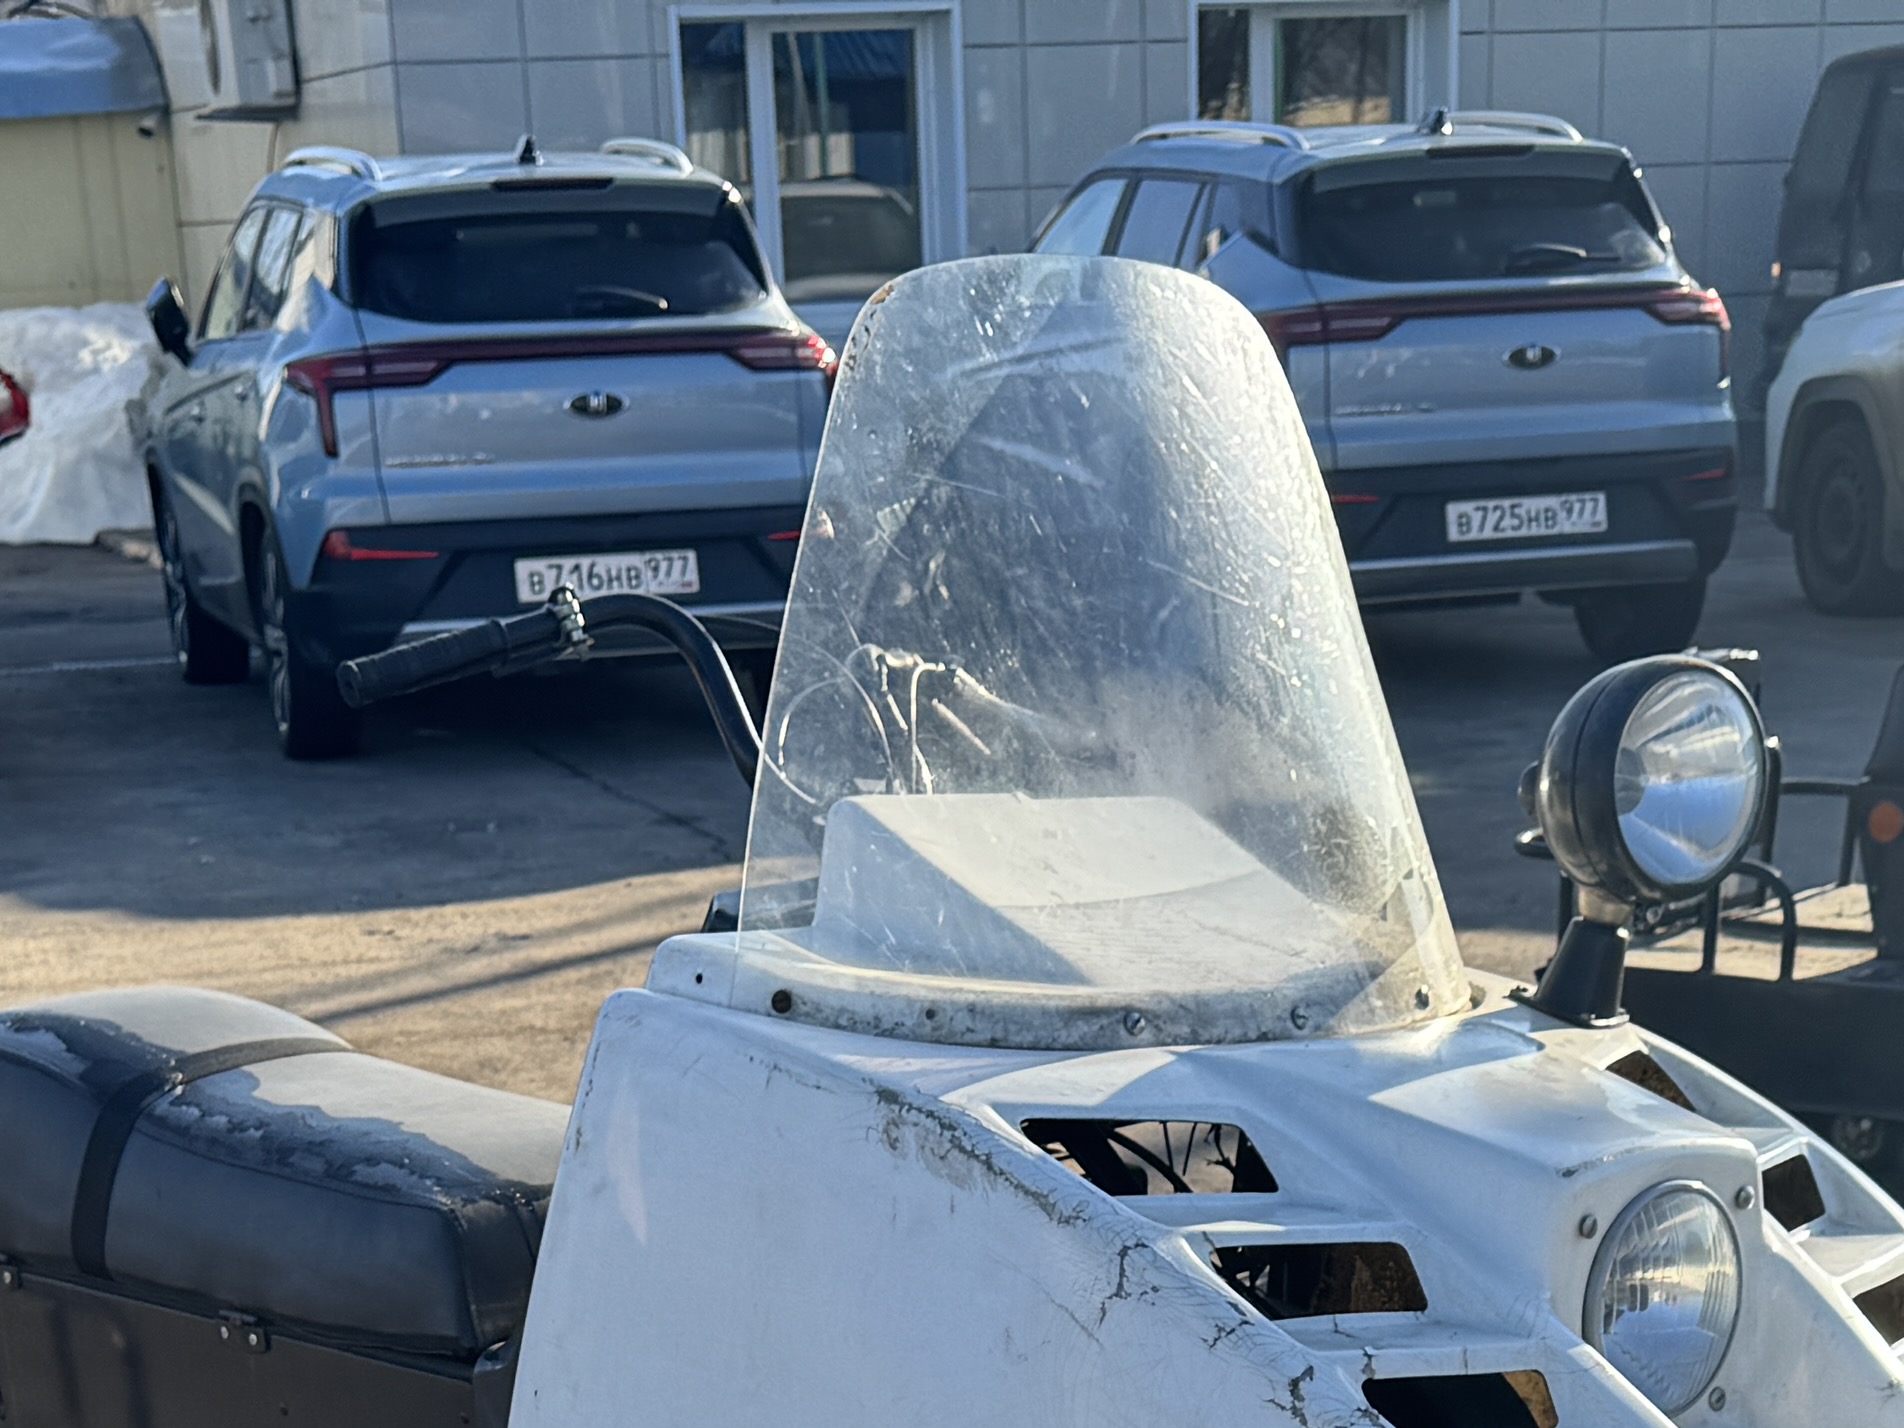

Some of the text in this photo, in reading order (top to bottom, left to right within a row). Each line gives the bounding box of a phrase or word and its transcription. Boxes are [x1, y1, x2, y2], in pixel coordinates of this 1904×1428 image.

[1456, 497, 1600, 536] В725НВ 977
[646, 555, 690, 580] 977
